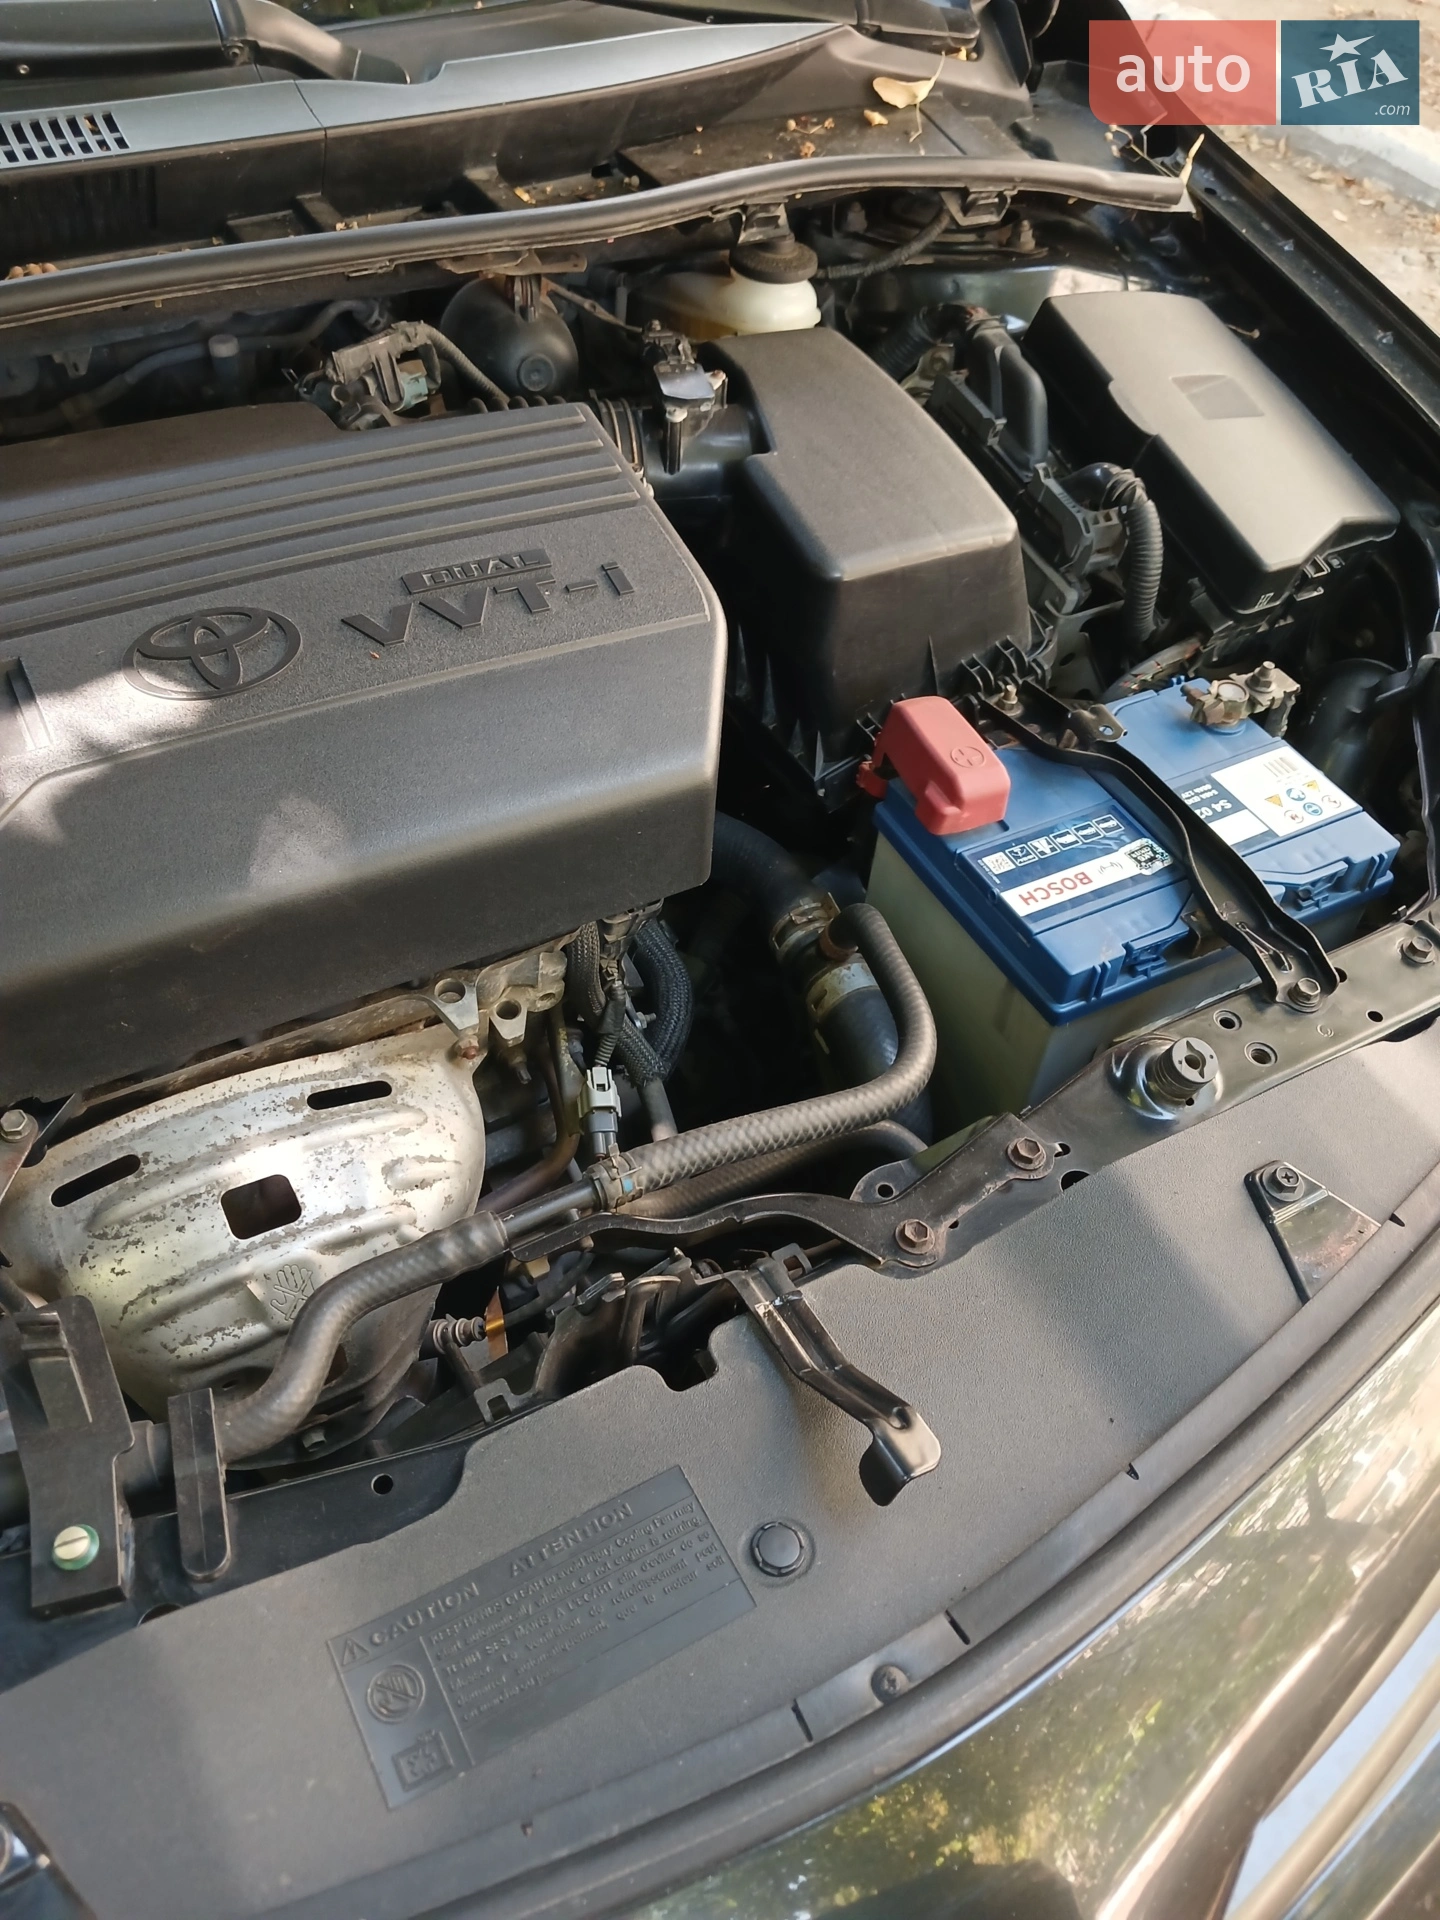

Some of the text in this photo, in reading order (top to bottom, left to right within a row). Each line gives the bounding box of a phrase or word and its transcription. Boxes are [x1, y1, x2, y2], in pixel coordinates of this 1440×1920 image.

[421, 552, 540, 587] DUAL
[1211, 799, 1233, 813] S4
[1019, 871, 1093, 906] BOSCH
[369, 1504, 632, 1648] CAUTION ATTENTION
[431, 1624, 460, 1643] KEEP
[464, 1602, 502, 1626] HANDS
[506, 1582, 543, 1604] CLEAR
[615, 1524, 653, 1548] Cooling
[675, 1504, 695, 1518] may
[534, 1580, 576, 1607] whether
[594, 1563, 610, 1575] not
[613, 1544, 647, 1566] engine
[663, 1516, 701, 1540] running.
[611, 1560, 688, 1605] refroidissement
[695, 1544, 717, 1561] peut
[616, 1605, 637, 1620] que
[663, 1572, 699, 1595] moteur
[486, 1637, 509, 1653] SES
[514, 1615, 550, 1638] MAINS
